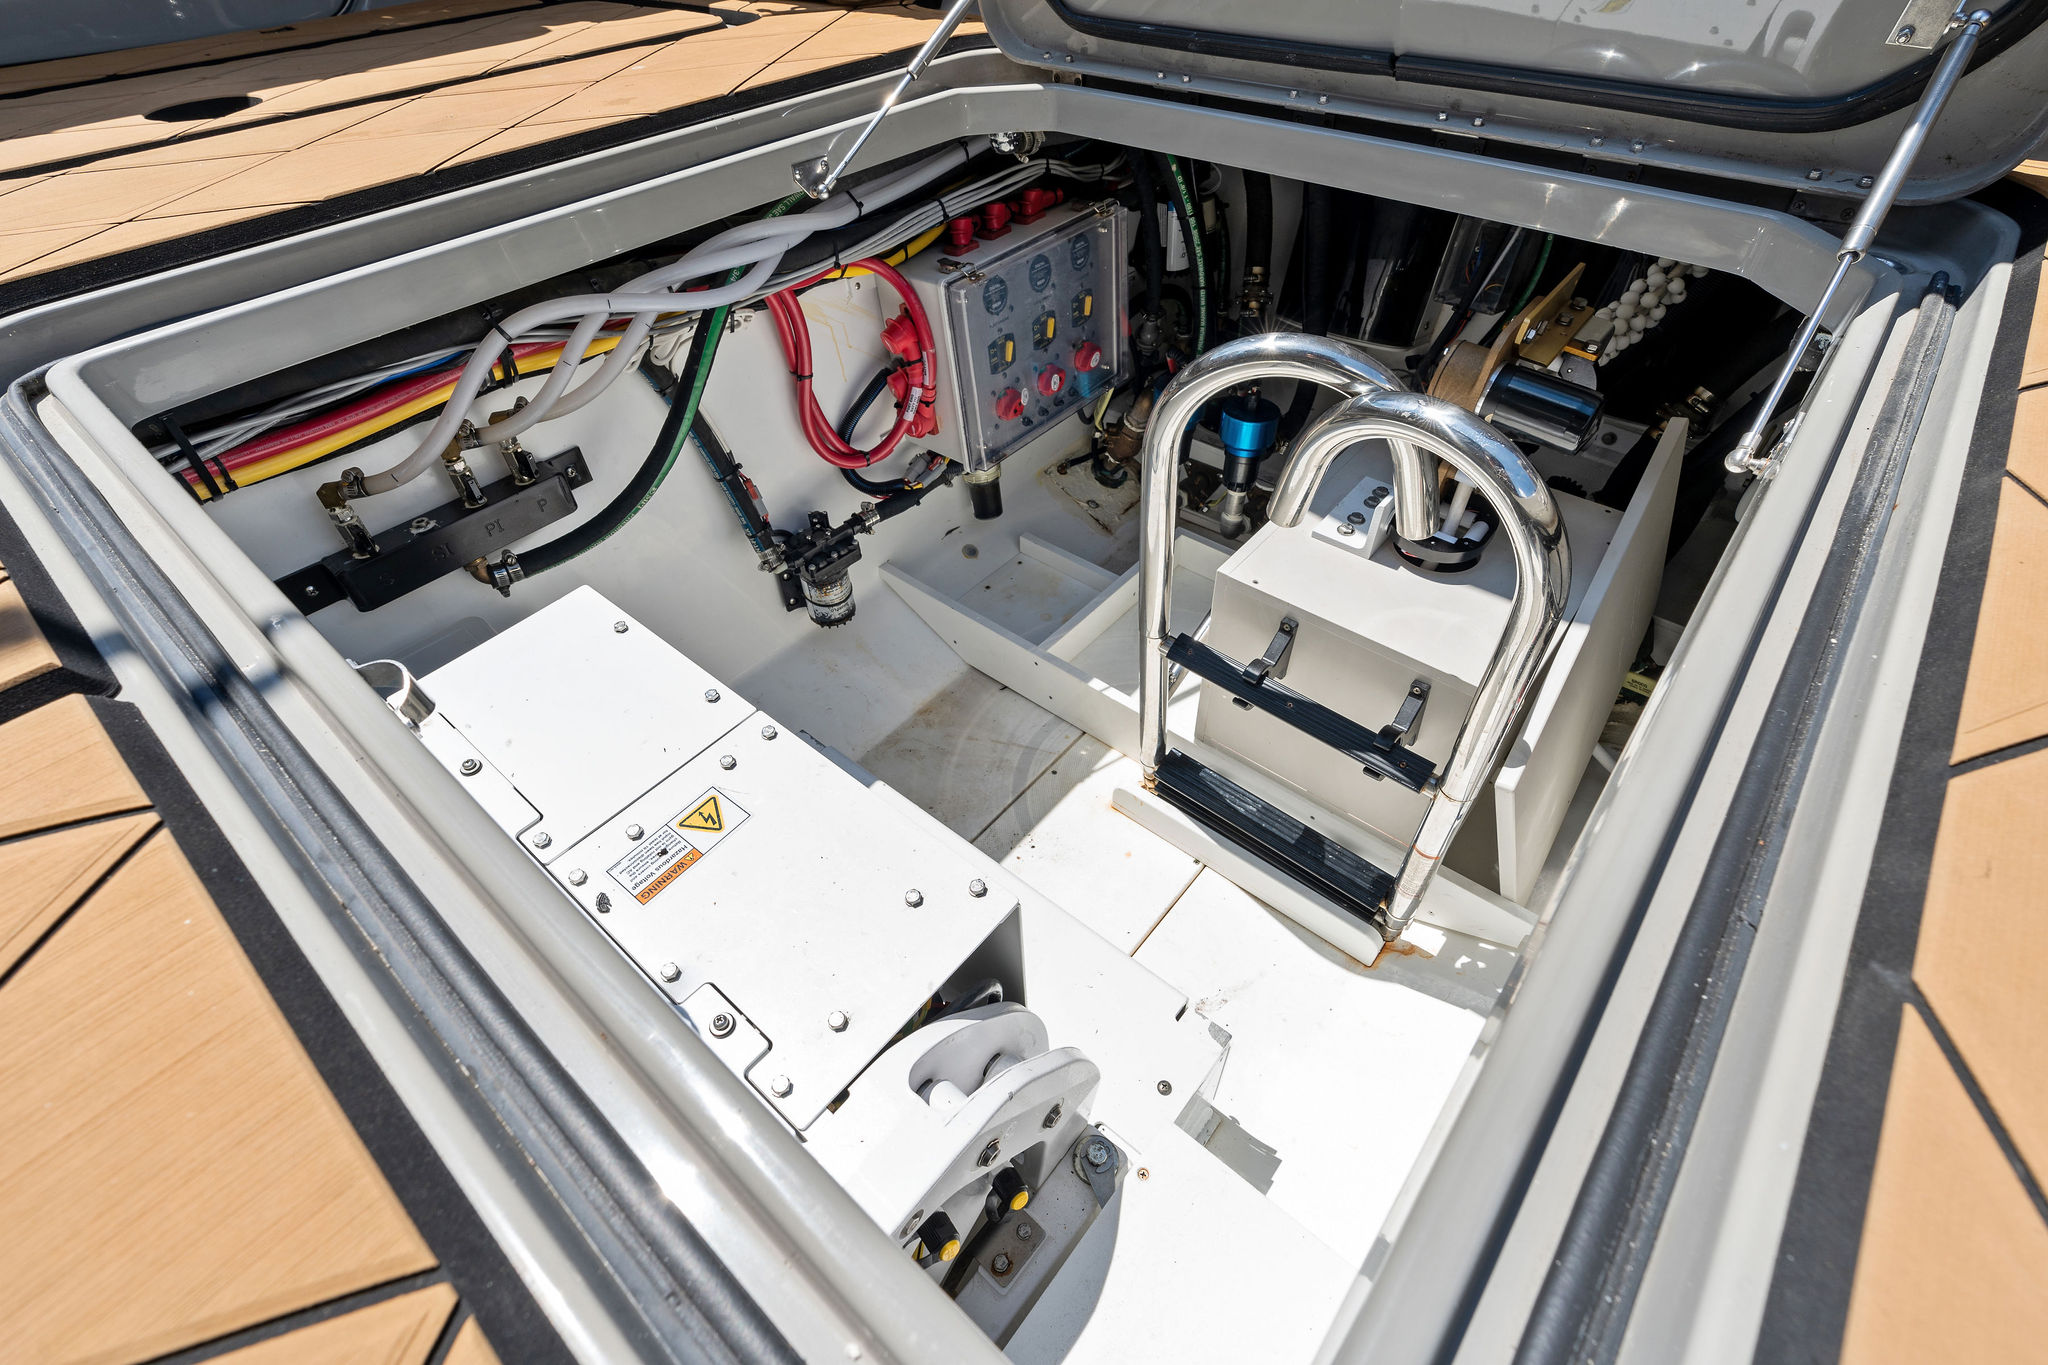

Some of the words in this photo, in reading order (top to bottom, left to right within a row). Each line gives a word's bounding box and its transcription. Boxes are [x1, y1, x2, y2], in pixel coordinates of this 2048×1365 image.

[484, 519, 504, 537] PI
[537, 498, 548, 513] P
[654, 844, 688, 872] Hazardous
[631, 871, 656, 891] Voltage
[639, 859, 688, 900] WARNING
